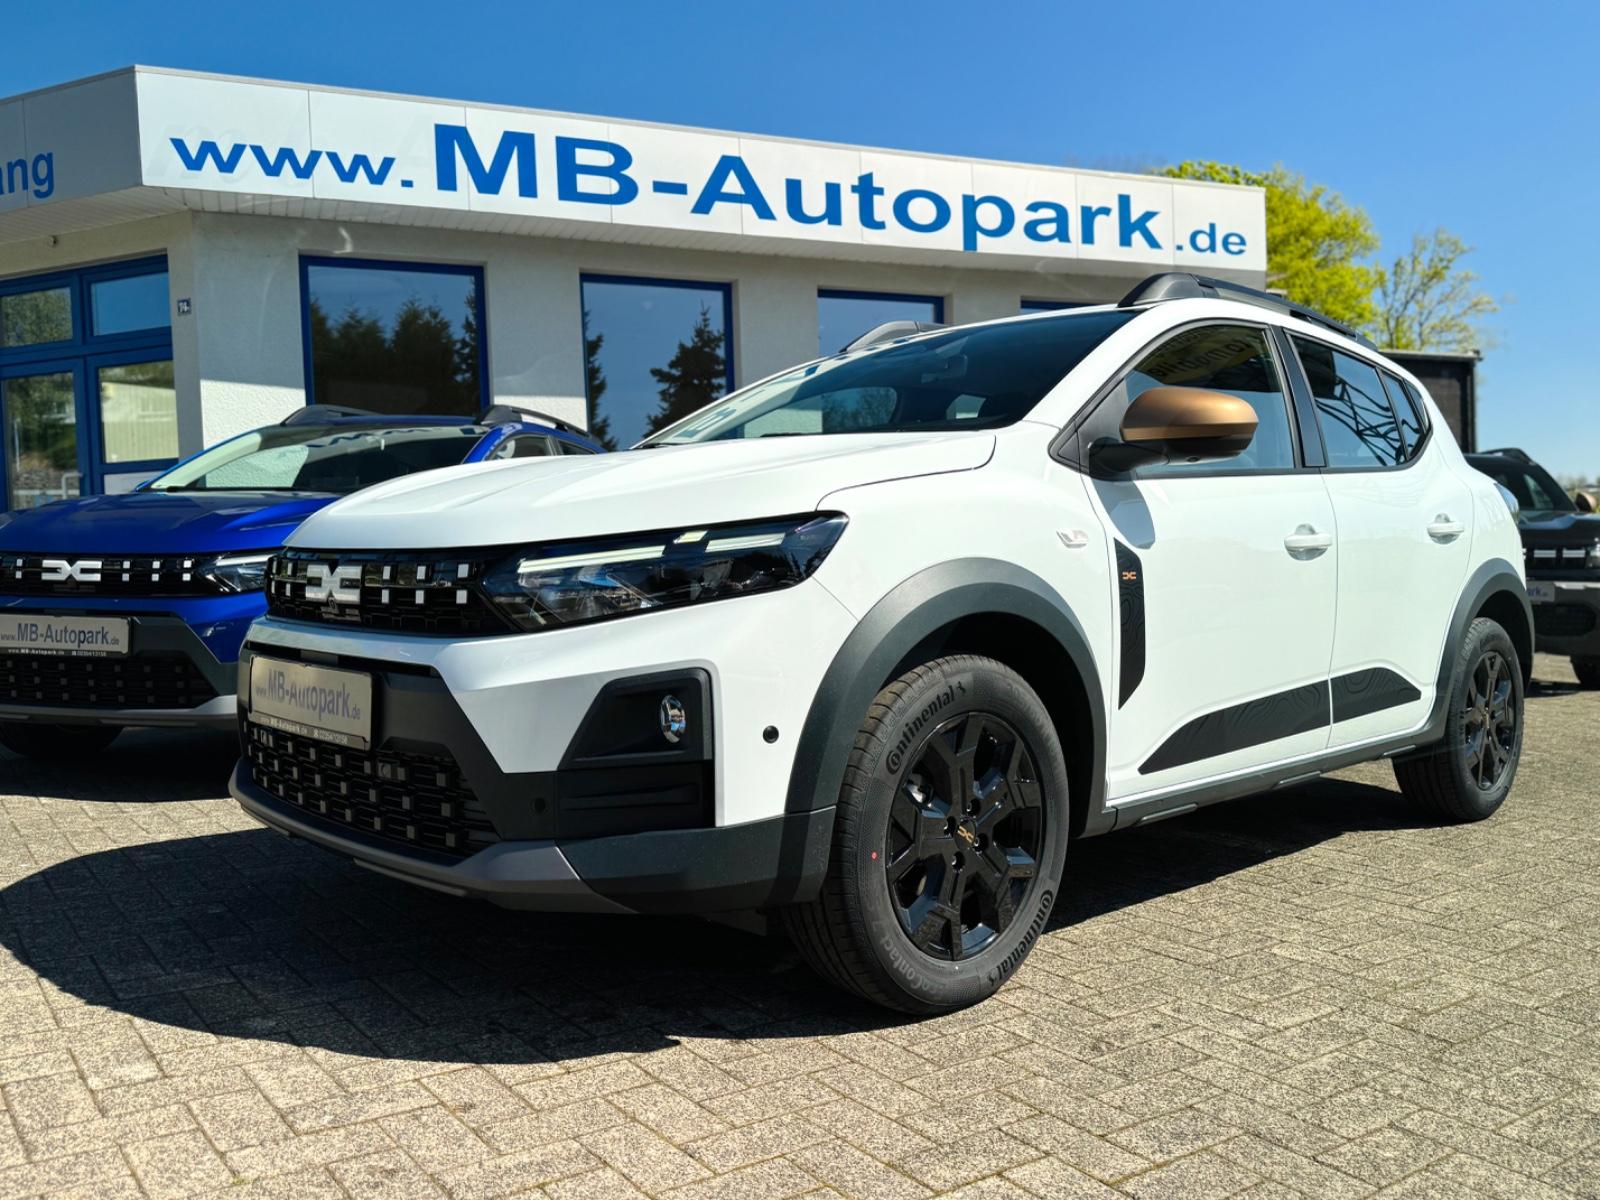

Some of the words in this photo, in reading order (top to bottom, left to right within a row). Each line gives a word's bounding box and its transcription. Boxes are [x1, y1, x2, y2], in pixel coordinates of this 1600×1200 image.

[0, 151, 54, 199] ng
[169, 122, 1248, 257] www.MB-Autopark.de
[886, 684, 955, 775] Continental
[999, 888, 1054, 981] Continental
